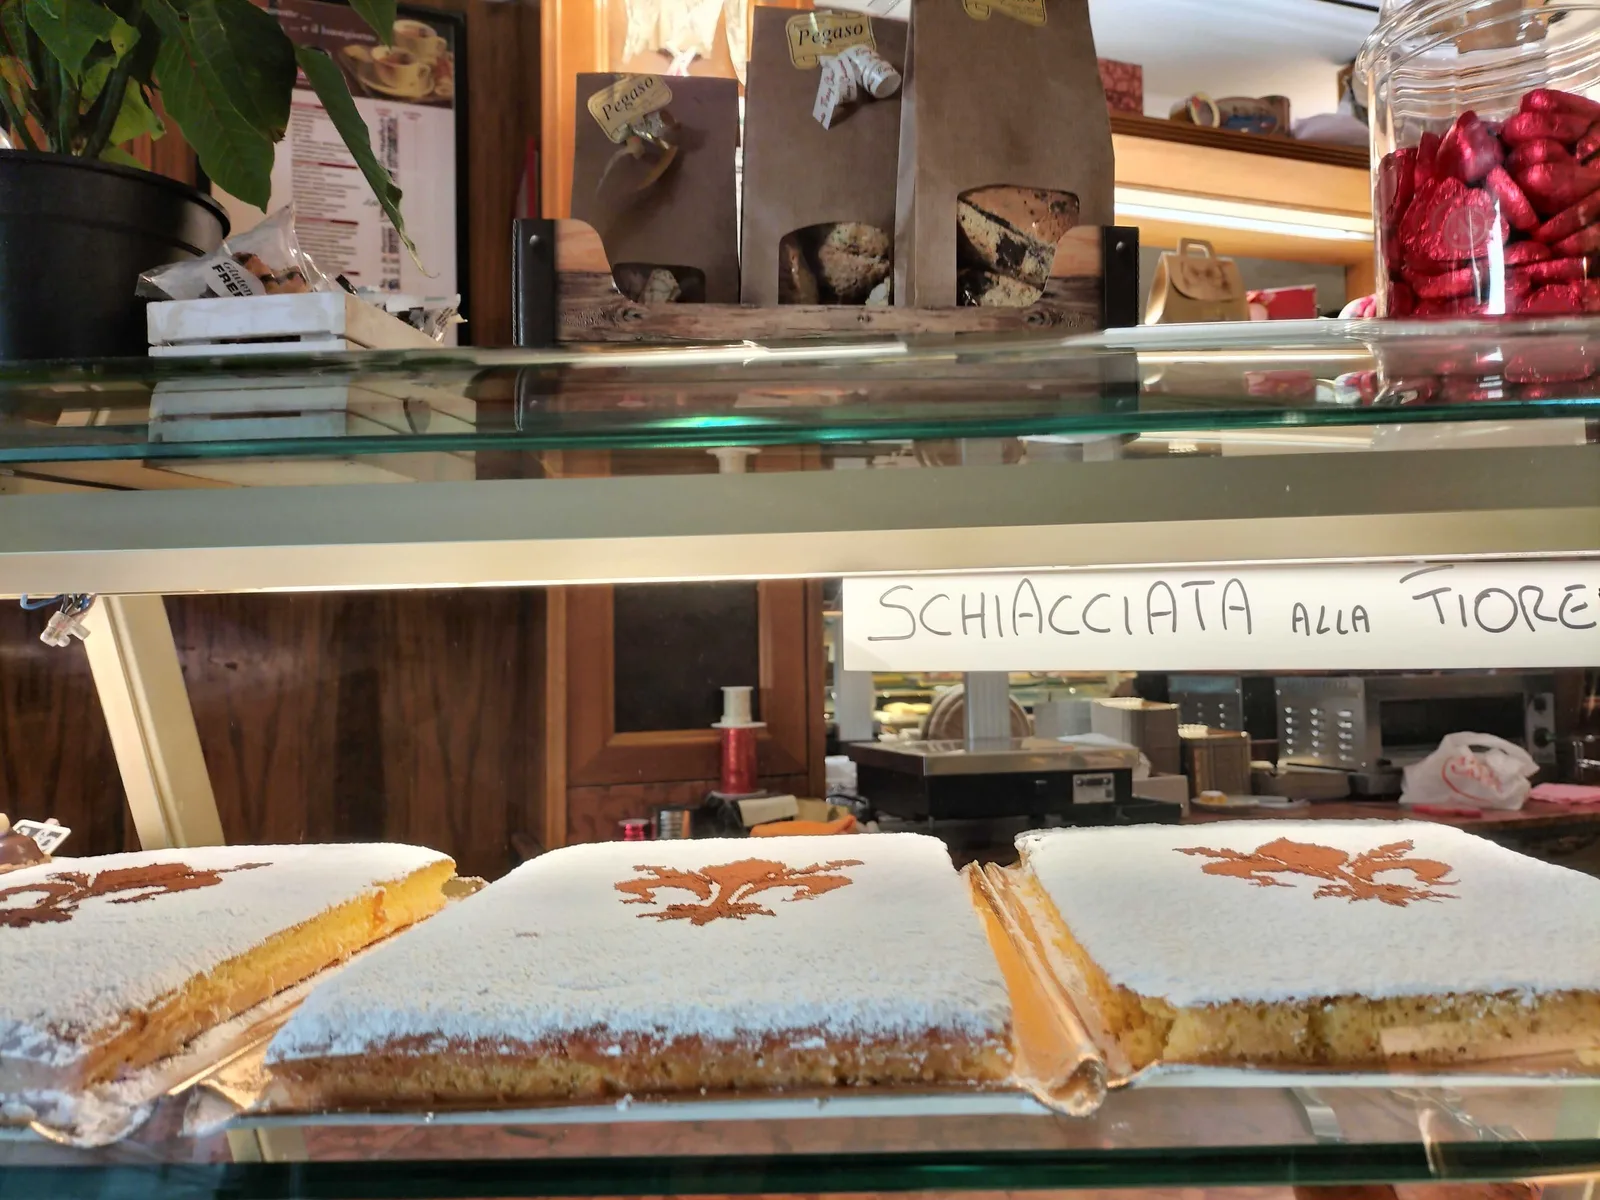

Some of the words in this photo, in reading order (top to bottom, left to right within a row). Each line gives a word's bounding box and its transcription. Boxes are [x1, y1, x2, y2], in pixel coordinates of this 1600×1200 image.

[798, 23, 864, 46] Pegaso
[601, 76, 655, 121] Pegaso
[222, 261, 254, 297] Gluten
[867, 577, 1252, 641] SCHIACCIATA
[1292, 602, 1370, 636] ALLA
[1399, 564, 1600, 634] FIORE
